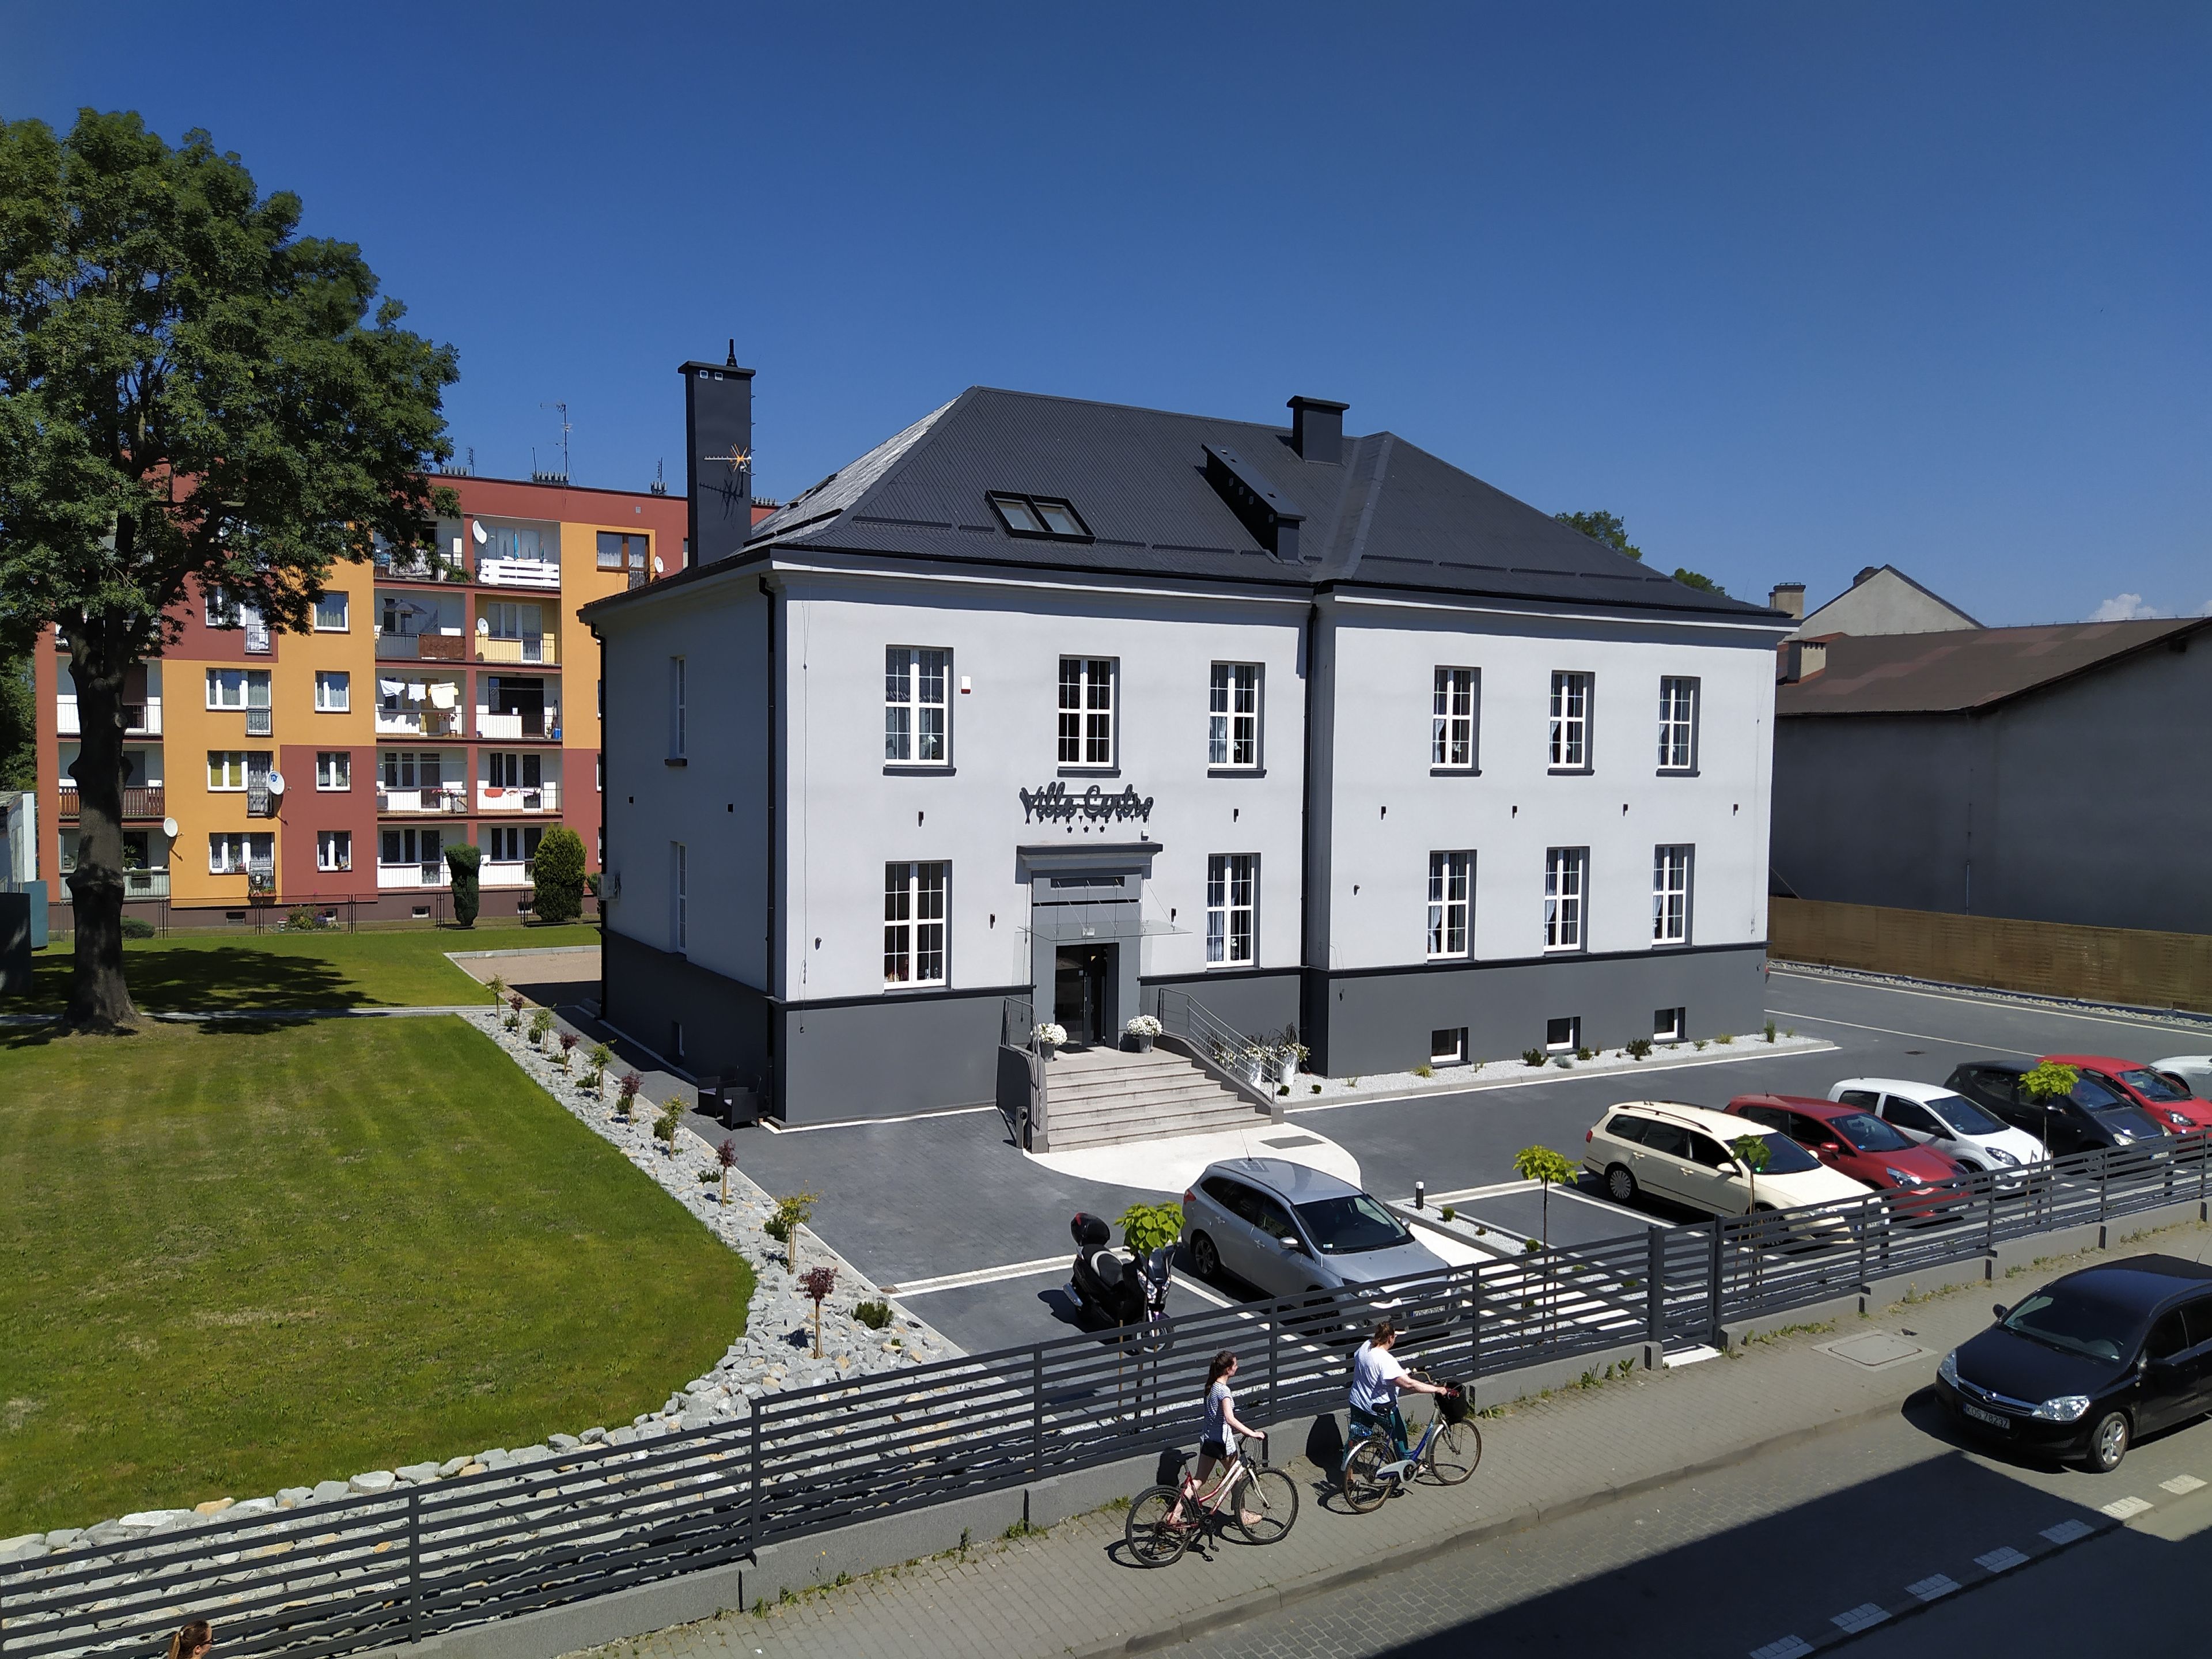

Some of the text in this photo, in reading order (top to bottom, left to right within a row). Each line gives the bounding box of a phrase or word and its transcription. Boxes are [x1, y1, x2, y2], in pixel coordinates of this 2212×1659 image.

[1019, 781, 1154, 819] Villa Centro
[1967, 1406, 2008, 1427] KOS 78237
